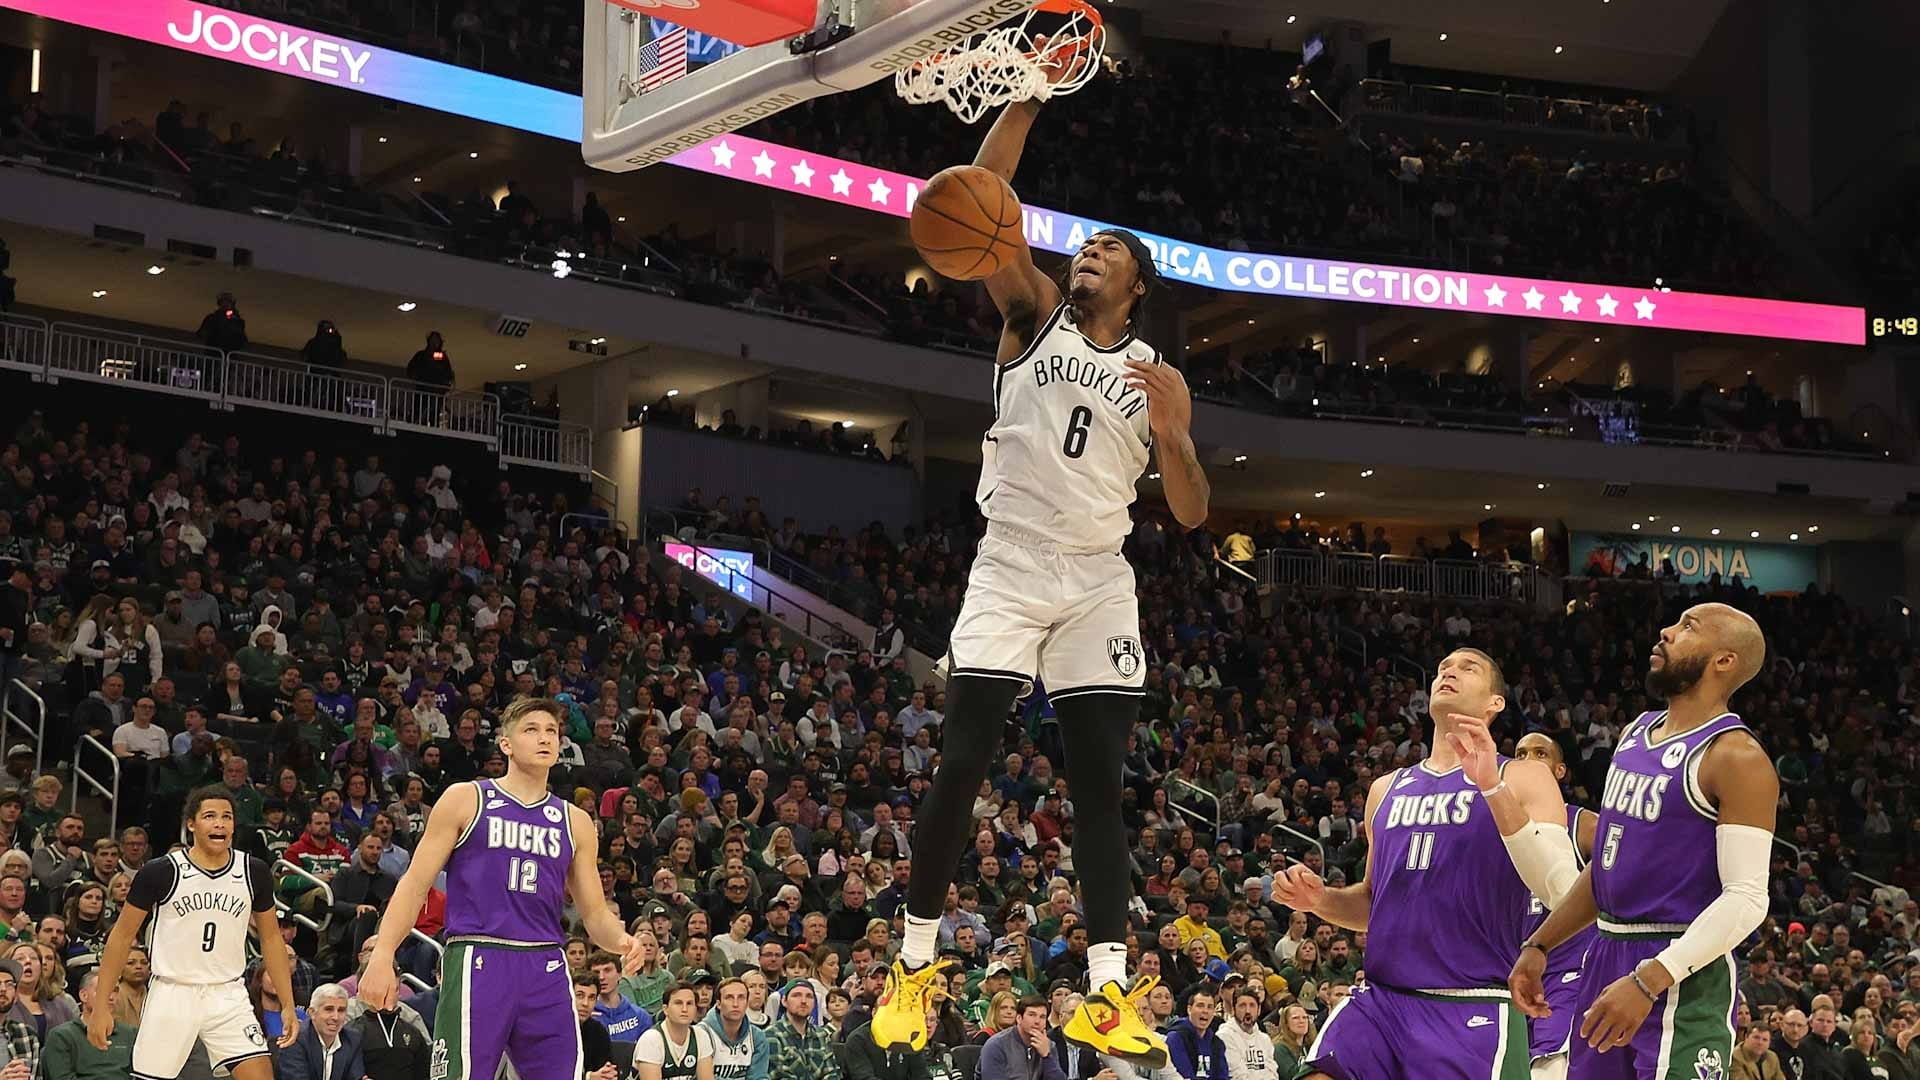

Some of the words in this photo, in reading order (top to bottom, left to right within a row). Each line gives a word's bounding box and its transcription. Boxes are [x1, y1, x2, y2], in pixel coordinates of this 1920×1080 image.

[167, 9, 372, 84] JOCKEY
[625, 92, 800, 167] SHOP.BUCKS.COM
[1226, 256, 1469, 306] COLLECTION
[497, 319, 532, 338] 106
[1873, 318, 1918, 337] 8:49
[1033, 354, 1146, 421] BROOKLYN
[1063, 405, 1093, 459] 6
[1651, 543, 1751, 578] KONA
[1111, 638, 1140, 658] NETS
[1384, 789, 1480, 831] BUCKS
[486, 815, 563, 859] BUCKS
[1405, 831, 1436, 871] 11
[1601, 822, 1625, 871] 5
[507, 856, 539, 894] 12
[172, 892, 247, 918] BROOKLYN
[202, 921, 218, 953] 9
